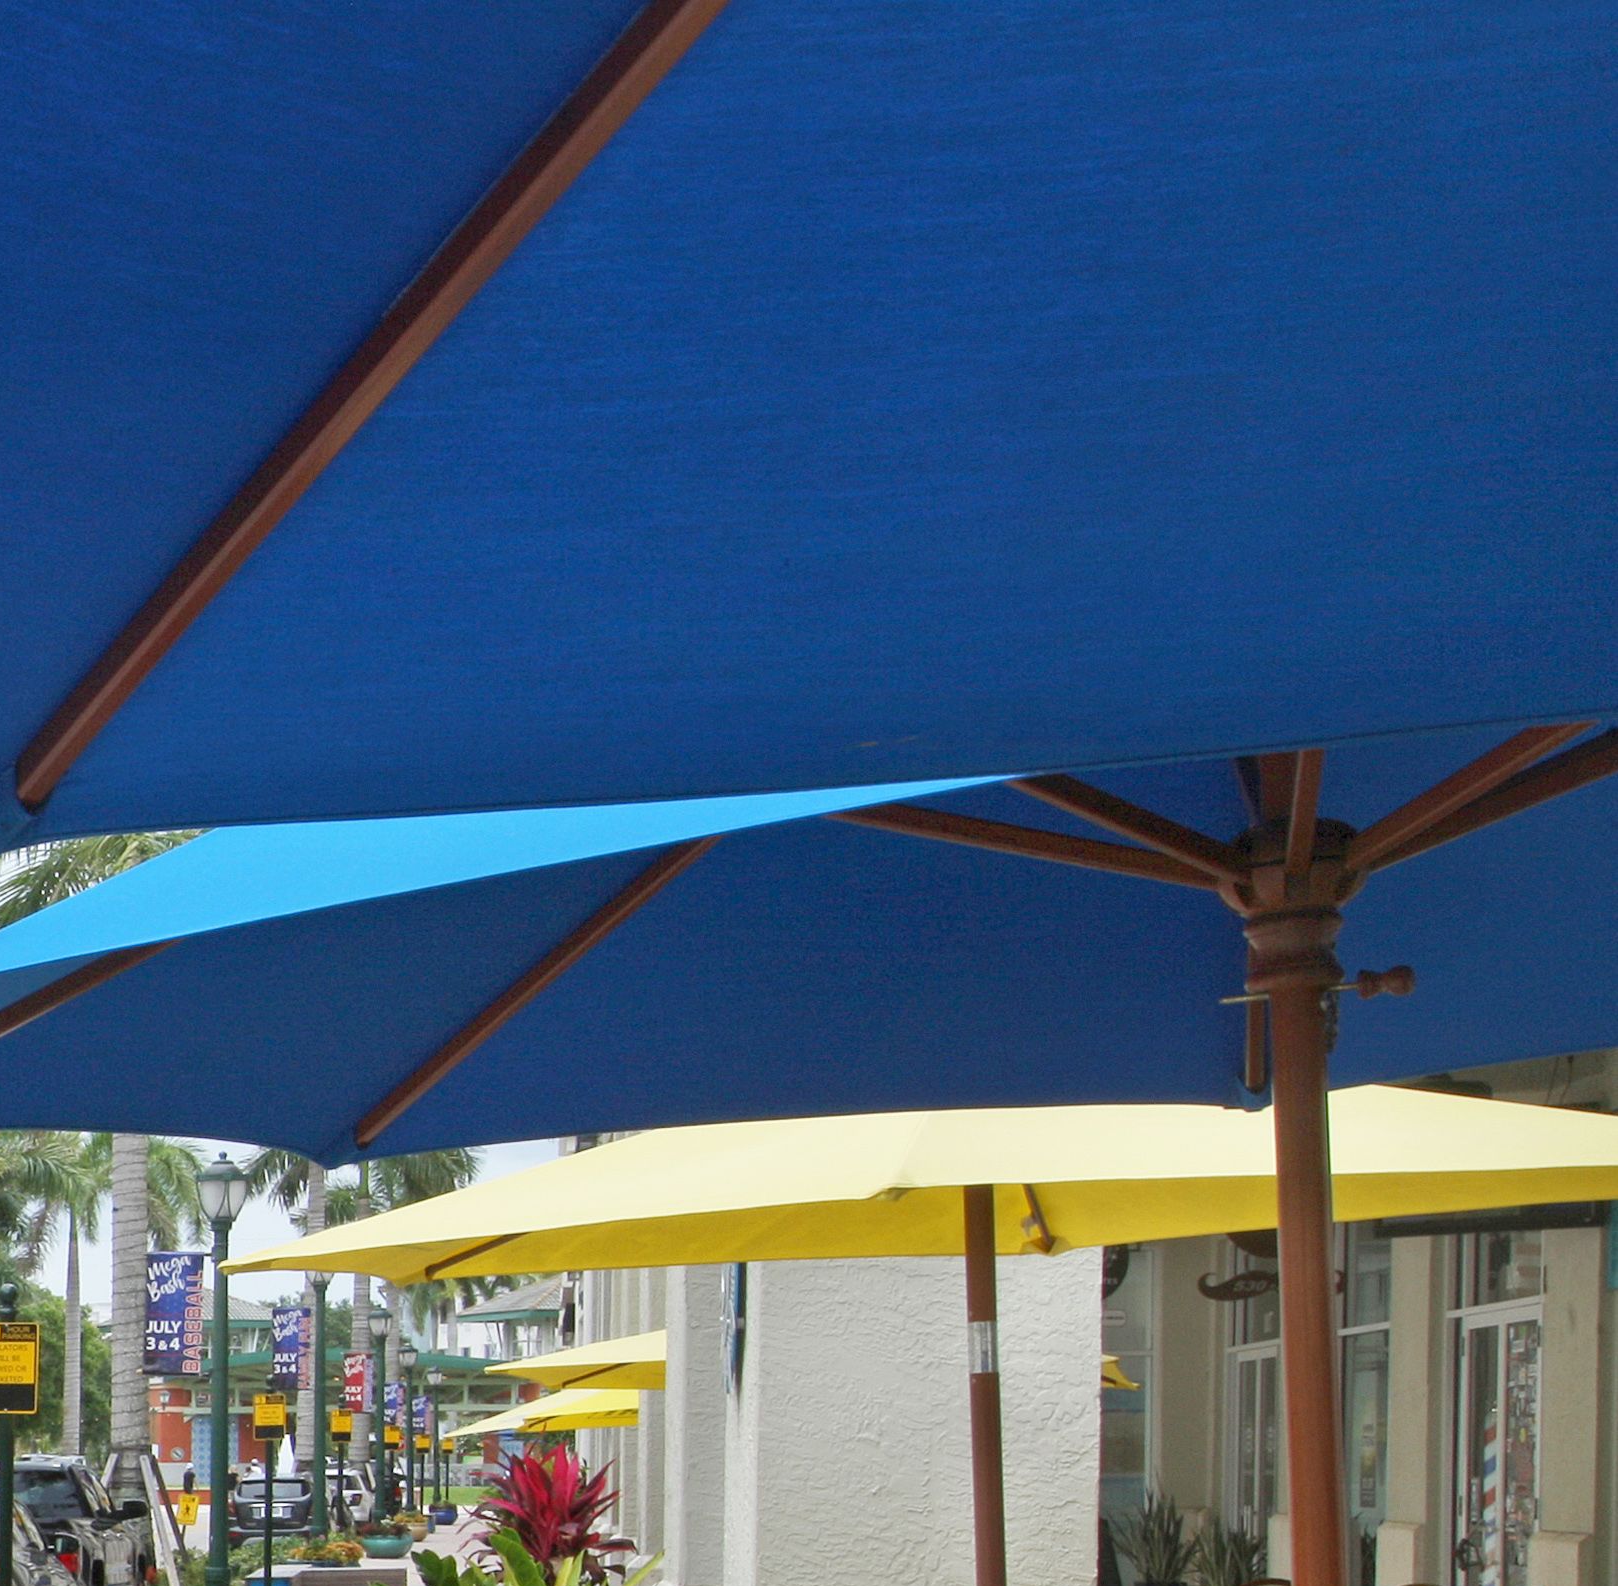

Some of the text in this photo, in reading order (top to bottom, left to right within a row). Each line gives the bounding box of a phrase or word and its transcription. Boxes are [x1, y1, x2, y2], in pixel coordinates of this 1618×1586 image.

[148, 1256, 191, 1281] Mega
[146, 1272, 185, 1303] Bash
[145, 1320, 182, 1334] JULY
[182, 1270, 204, 1374] BASEBALL
[273, 1352, 297, 1363] JULY
